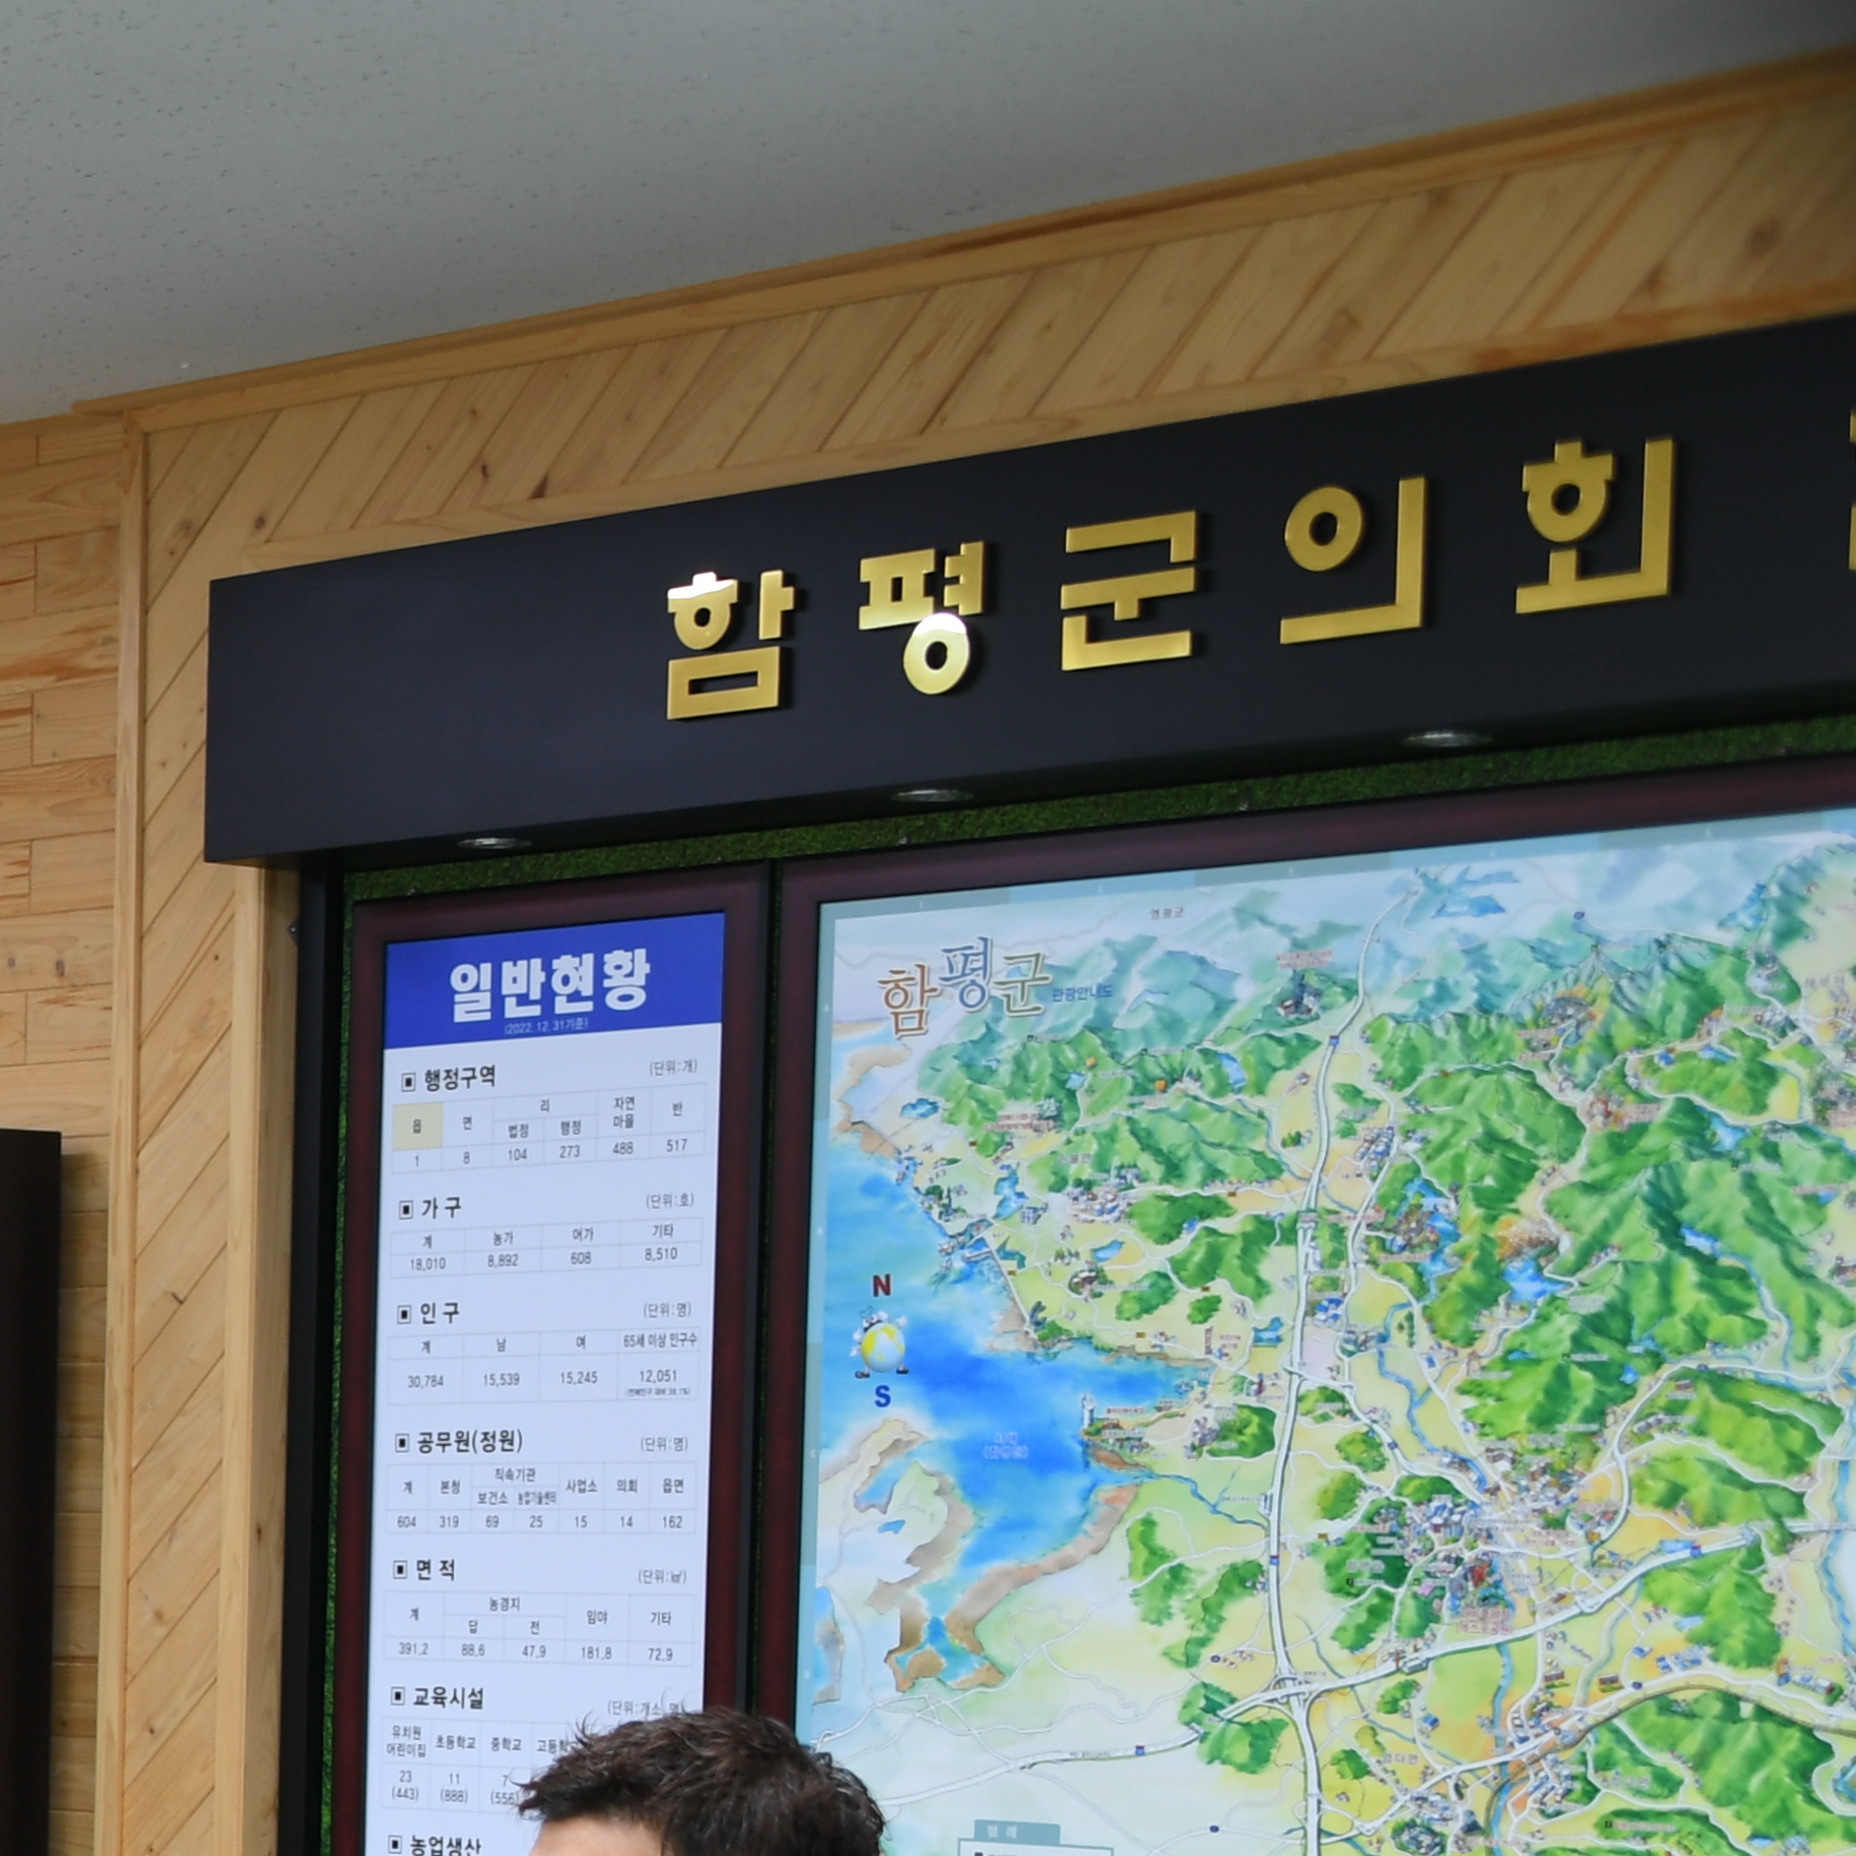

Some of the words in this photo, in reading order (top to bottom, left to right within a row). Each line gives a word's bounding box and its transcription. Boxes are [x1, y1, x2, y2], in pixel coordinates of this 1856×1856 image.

[668, 438, 1676, 720] 함평군의회
[449, 948, 651, 1023] 일반현황
[878, 936, 1051, 1036] 함평군
[1052, 984, 1113, 1003] 관광안내도
[649, 1059, 697, 1076] (단위:개)
[424, 1065, 496, 1092] 행정구역
[540, 1099, 550, 1112] 리
[614, 1096, 635, 1111] 자연
[672, 1101, 683, 1116] 반
[462, 1116, 473, 1131] 면
[560, 1120, 582, 1136] 행정
[613, 1114, 634, 1129] 마을
[508, 1124, 529, 1138] 법정
[559, 1146, 581, 1159] 273
[612, 1141, 634, 1155] 488
[666, 1139, 688, 1152] 517
[463, 1152, 470, 1164] 8
[508, 1149, 527, 1161] 104
[646, 1192, 694, 1209] (단위:호)
[572, 1227, 594, 1242] 어가
[652, 1223, 674, 1238] 기타
[423, 1235, 432, 1249] 계
[493, 1231, 514, 1246] 농가
[487, 1254, 519, 1268] 8,892
[571, 1252, 592, 1265] 608
[644, 1248, 678, 1263] 8,510
[410, 1257, 446, 1272] 18,010
[873, 1274, 890, 1297] N
[643, 1302, 692, 1319] (단위:명)
[496, 1338, 507, 1352] 남
[576, 1336, 586, 1350] 여
[623, 1334, 645, 1348] 65세
[648, 1333, 666, 1348] 이상
[670, 1331, 697, 1348] 인구수
[421, 1341, 431, 1354] 계
[407, 1375, 444, 1389] 30,784
[483, 1373, 520, 1387] 15,539
[560, 1372, 598, 1386] 15,245
[639, 1370, 678, 1384] 12,051
[875, 1385, 891, 1407] S
[417, 1429, 523, 1454] 공무원(정원)
[640, 1436, 688, 1452] (단위:명)
[494, 1467, 536, 1483] 직속기관
[403, 1481, 413, 1494] 계
[440, 1479, 461, 1495] 본청
[566, 1478, 598, 1494] 사업소
[617, 1478, 638, 1494] 의회
[662, 1478, 684, 1494] 읍면
[477, 1490, 508, 1506] 보건소
[397, 1515, 417, 1529] 604
[439, 1515, 459, 1529] 319
[486, 1515, 500, 1529] 69
[529, 1515, 543, 1529] 25
[574, 1515, 588, 1529] 15
[619, 1515, 634, 1529] 14
[662, 1515, 683, 1529] 162
[489, 1596, 521, 1613] 농경지
[410, 1607, 419, 1621] 계
[586, 1610, 608, 1625] 임야
[649, 1610, 672, 1626] 기타
[468, 1619, 478, 1635] 답
[530, 1621, 541, 1636] 전
[412, 1686, 484, 1710] 교육시설
[392, 1725, 422, 1740] 유치원
[435, 1735, 476, 1750] 초등학교
[490, 1738, 522, 1752] 중학교
[386, 1744, 427, 1758] 어린이집
[399, 1770, 412, 1783] 23
[448, 1773, 460, 1785] 11
[502, 1775, 509, 1786] 7
[391, 1786, 419, 1801] (443)
[440, 1790, 468, 1804] (888)
[490, 1791, 519, 1806] (556)
